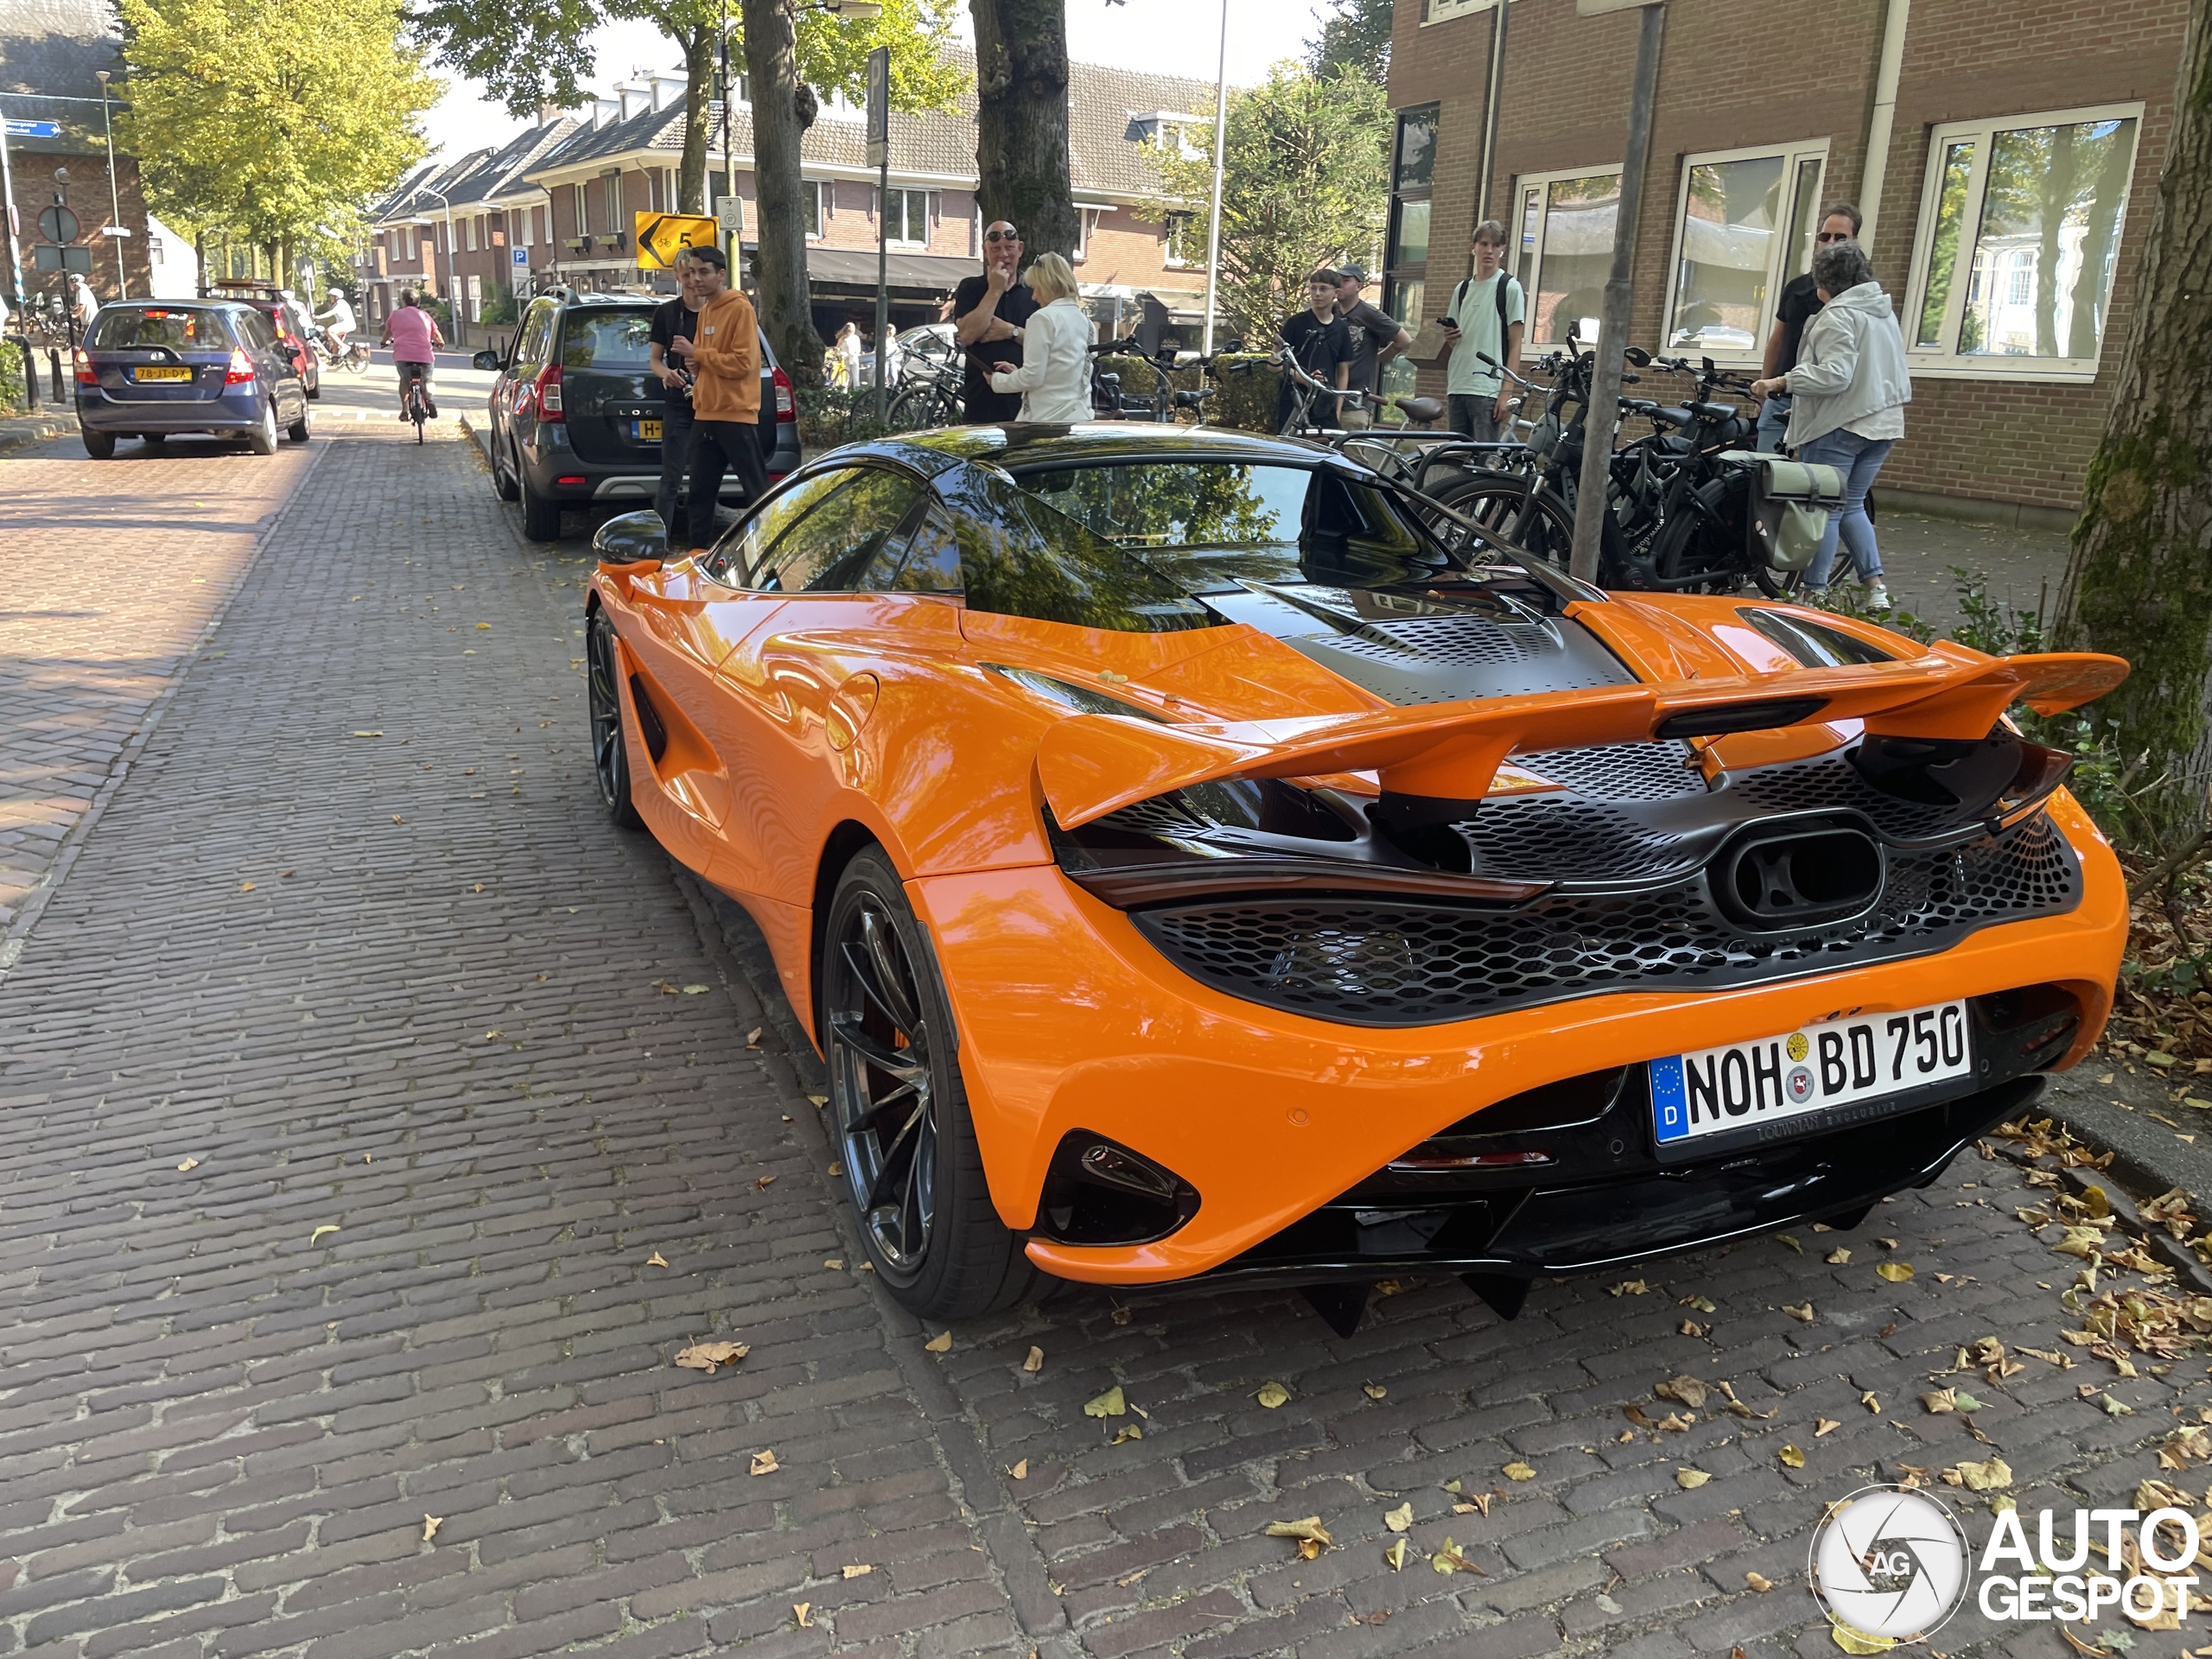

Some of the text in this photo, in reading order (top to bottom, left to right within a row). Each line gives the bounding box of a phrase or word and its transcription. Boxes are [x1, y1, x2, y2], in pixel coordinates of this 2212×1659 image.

[871, 58, 881, 103] P
[679, 232, 692, 249] 5
[516, 251, 524, 262] P
[139, 368, 187, 378] 78-JT-DX
[1686, 1042, 1783, 1124] NOH
[1818, 1025, 1877, 1096] BD
[1886, 1006, 1964, 1080] 750
[1665, 1106, 1678, 1125] D
[1757, 1102, 1896, 1141] LOUWMAN EXCLUSIVE
